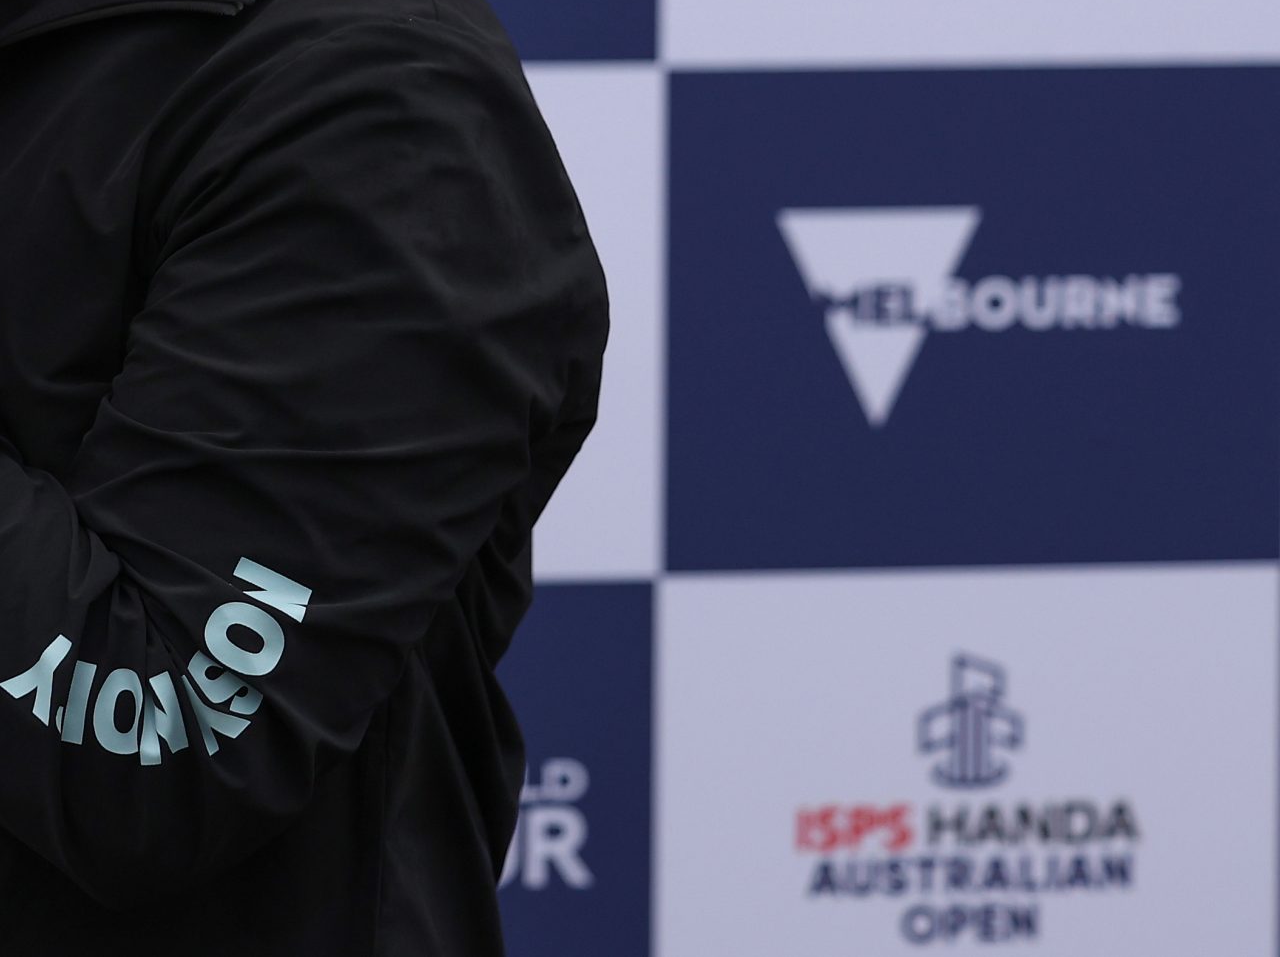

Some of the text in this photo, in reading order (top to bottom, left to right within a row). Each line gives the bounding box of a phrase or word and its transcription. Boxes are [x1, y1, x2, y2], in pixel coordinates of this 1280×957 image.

[818, 273, 1181, 331] MELBOURNE
[795, 800, 1140, 852] ISPS HANDA
[807, 852, 1135, 898] AUSTRALIAN
[900, 903, 1042, 945] OPEN
